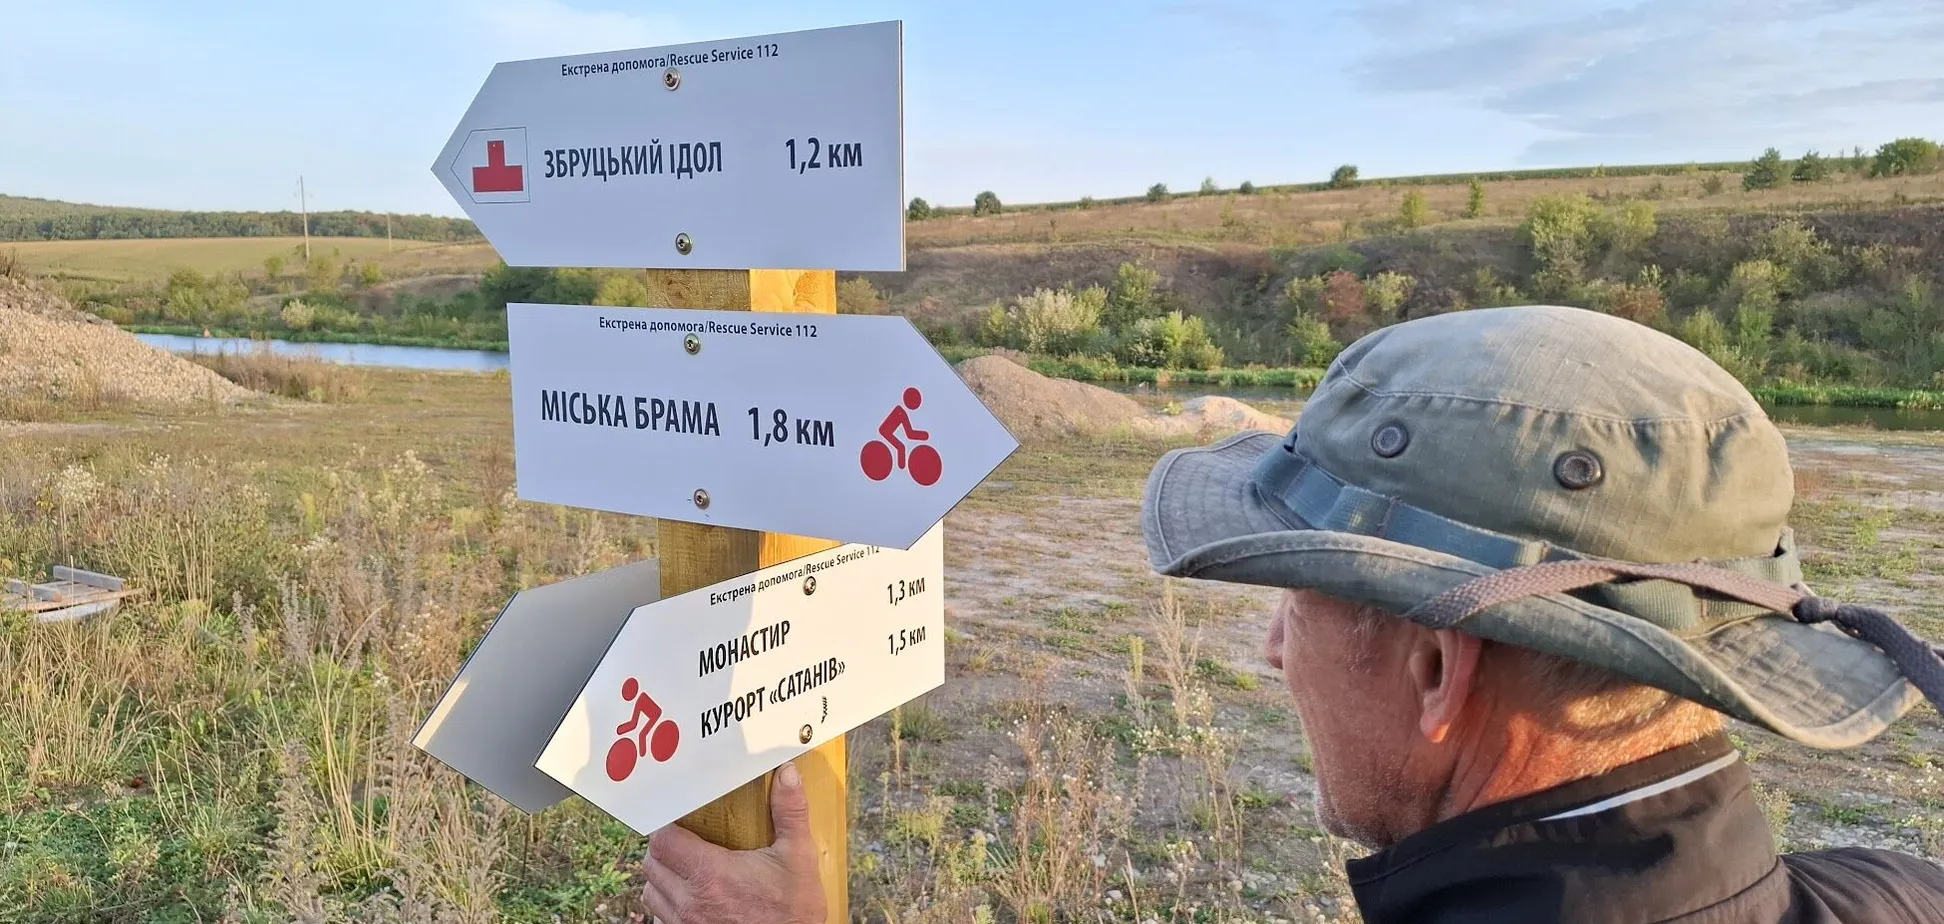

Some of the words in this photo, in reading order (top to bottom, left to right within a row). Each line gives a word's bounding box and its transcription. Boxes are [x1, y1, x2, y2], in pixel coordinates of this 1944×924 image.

[561, 61, 610, 78] Екстрена
[611, 51, 710, 76] допомога/Rescue
[711, 46, 754, 63] Service
[757, 43, 779, 59] 112
[544, 138, 663, 182] ЗБРУЦЬКИЙ
[669, 141, 722, 180] ІДОЛ
[785, 137, 821, 175] 1,2
[828, 142, 862, 168] км
[599, 316, 648, 333] Екстрена
[649, 320, 747, 335] допомога/Rescue
[750, 322, 793, 337] Service
[795, 324, 817, 337] 112
[541, 390, 627, 429] МІСЬКА
[634, 396, 720, 437] БРАМА
[747, 407, 788, 447] 1,8
[796, 418, 835, 448] км
[710, 584, 756, 606] Екстрена
[757, 557, 835, 592] допомога/Rescue
[836, 549, 865, 566] Service
[887, 580, 905, 606] 1,3
[909, 577, 925, 597] км
[699, 620, 791, 678] МОНАСТИР
[888, 629, 906, 656] 1,5
[910, 625, 926, 645] км
[701, 686, 766, 739] КУРОРТ
[769, 657, 846, 705] «САТАНІВ»
